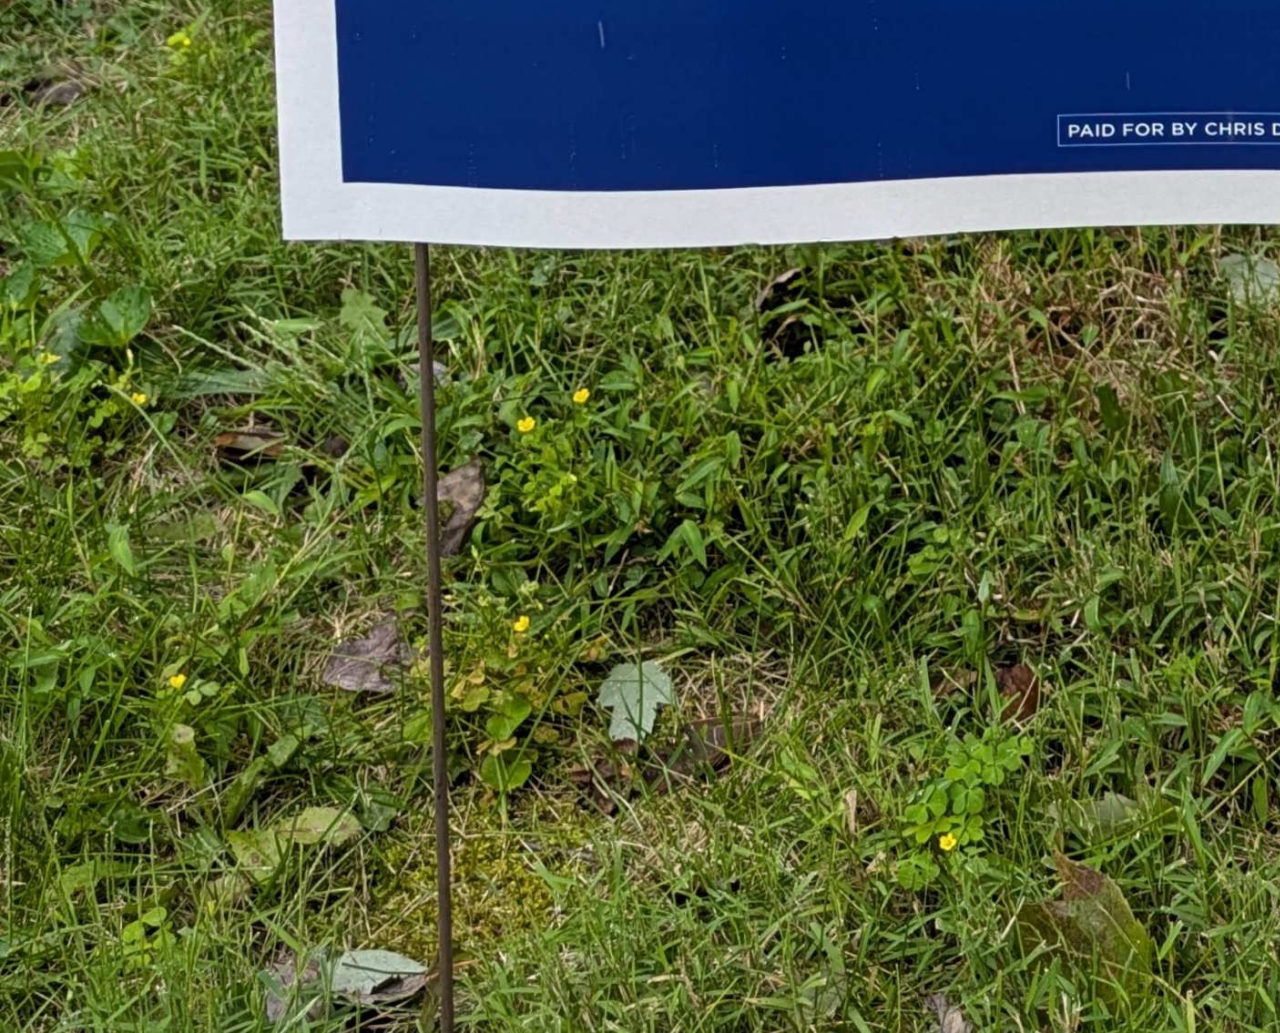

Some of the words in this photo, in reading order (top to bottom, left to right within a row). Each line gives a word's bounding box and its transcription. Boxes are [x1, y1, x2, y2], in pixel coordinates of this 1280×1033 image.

[1068, 123, 1116, 137] PAID
[1122, 123, 1164, 137] FOR
[1171, 122, 1198, 136] BY
[1204, 122, 1265, 136] CHRIS
